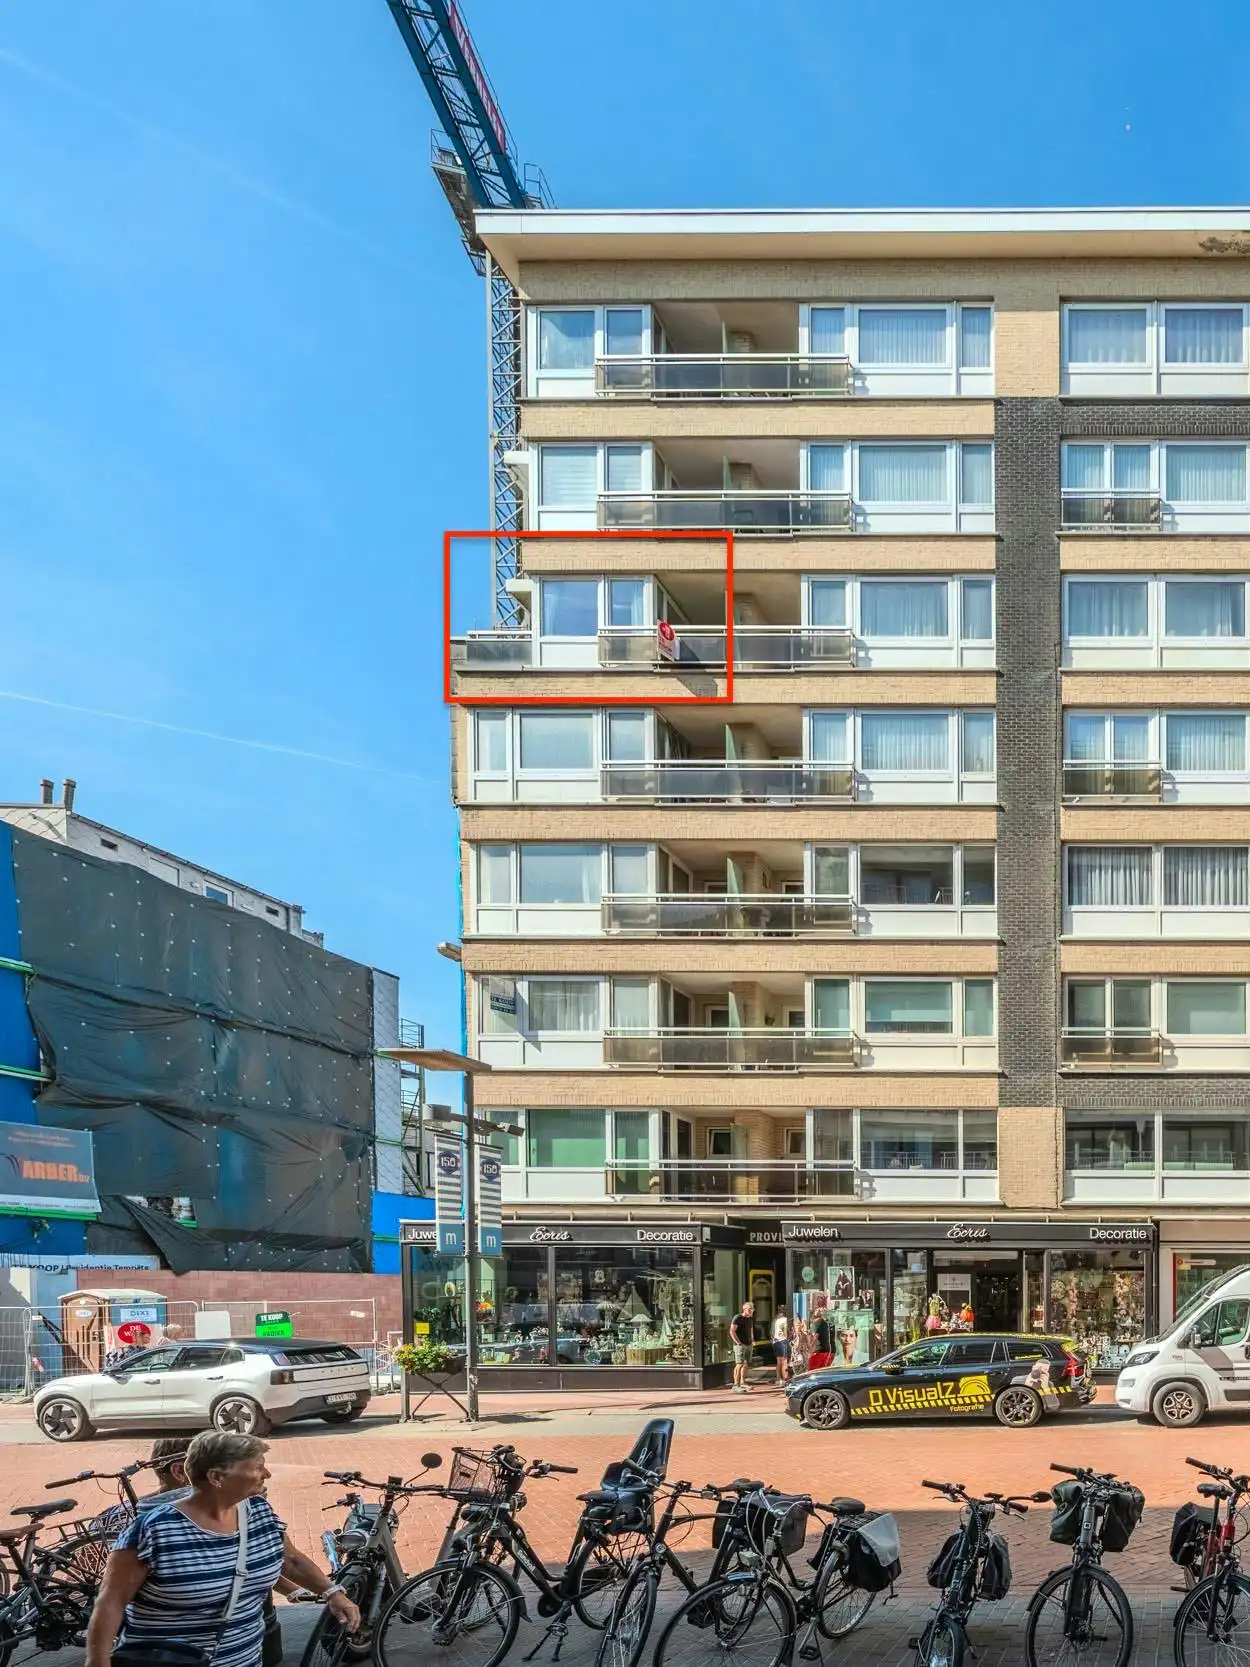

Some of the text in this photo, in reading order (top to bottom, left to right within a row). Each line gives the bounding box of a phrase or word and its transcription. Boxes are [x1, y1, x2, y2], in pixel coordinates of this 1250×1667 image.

[441, 1159, 456, 1167] 150
[483, 1164, 498, 1174] 150
[408, 1228, 437, 1240] Juwe
[636, 1229, 694, 1241] Decoratie
[749, 1232, 782, 1242] PROVI
[788, 1225, 838, 1237] Juwelen
[1089, 1227, 1147, 1239] Decoratie
[445, 1232, 457, 1245] m
[486, 1235, 497, 1247] m
